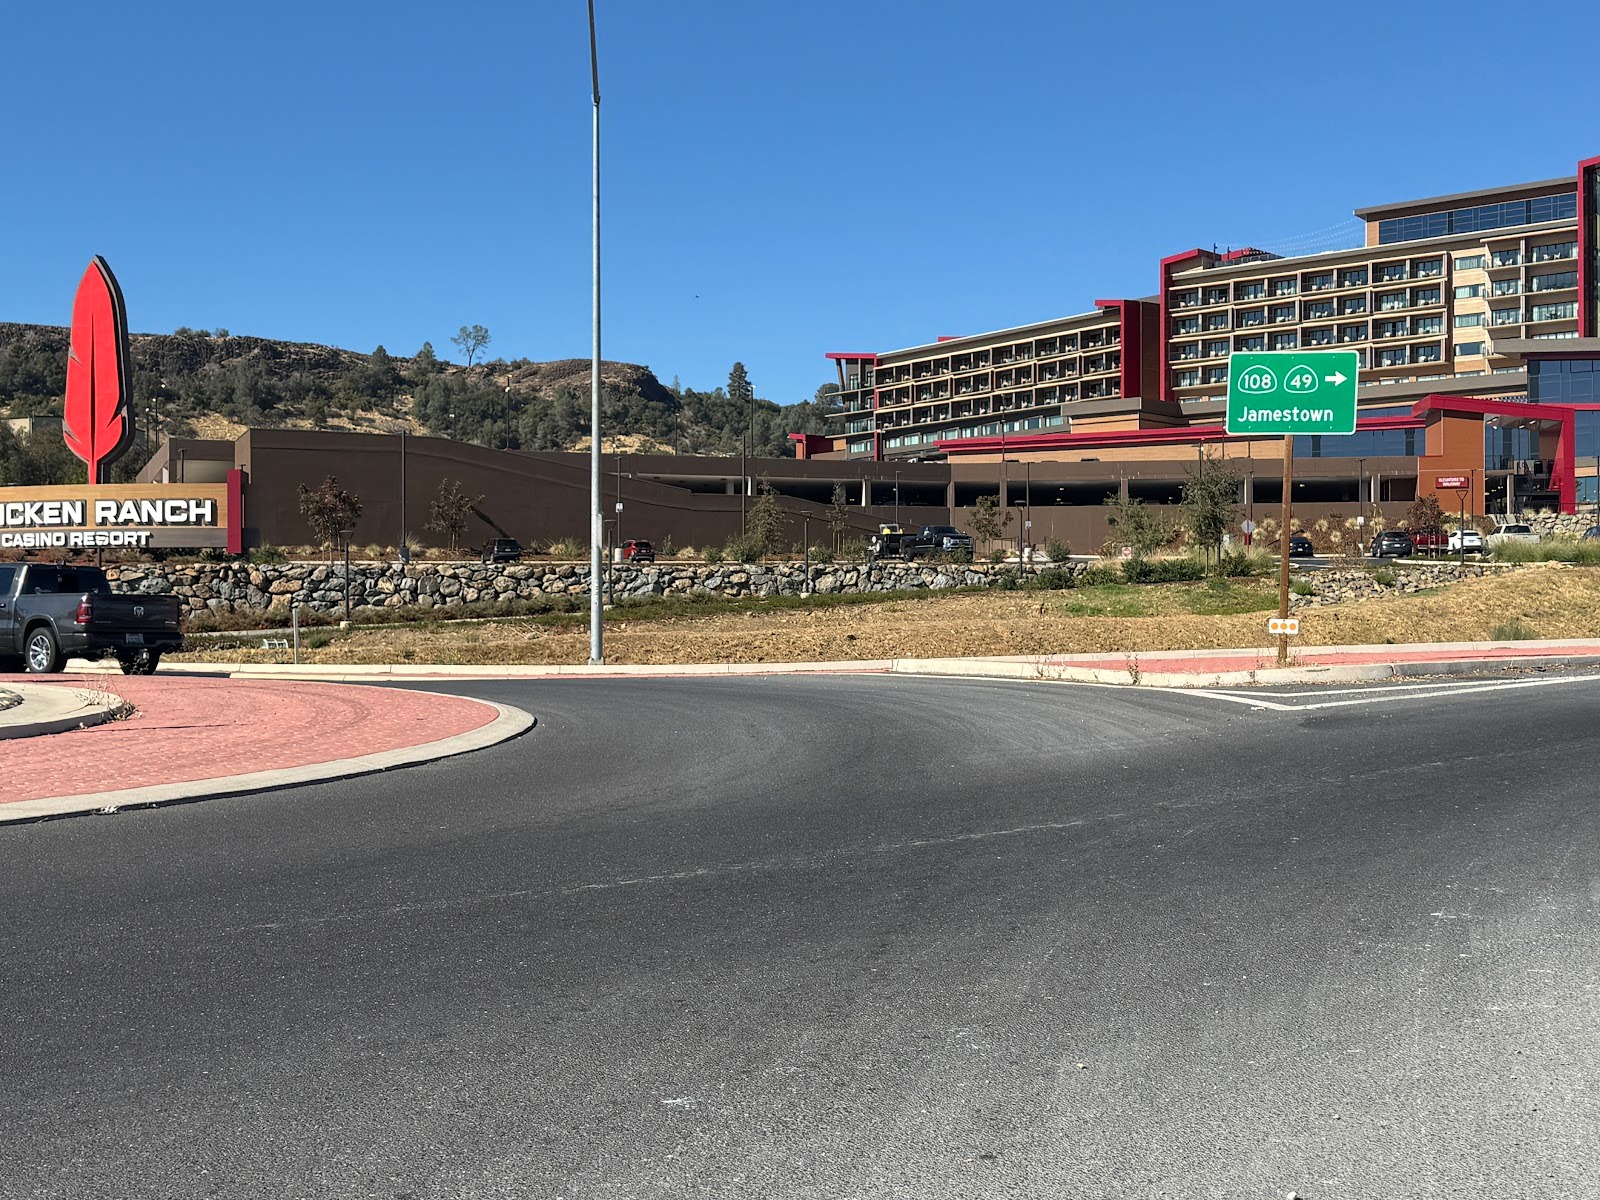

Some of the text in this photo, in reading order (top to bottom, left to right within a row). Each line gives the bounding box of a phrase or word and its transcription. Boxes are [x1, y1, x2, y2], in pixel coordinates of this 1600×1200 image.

[1244, 374, 1312, 389] 108 49
[1237, 406, 1334, 422] Jamestown
[95, 499, 212, 523] RANCH
[1, 531, 150, 547] CASINO RESORT
